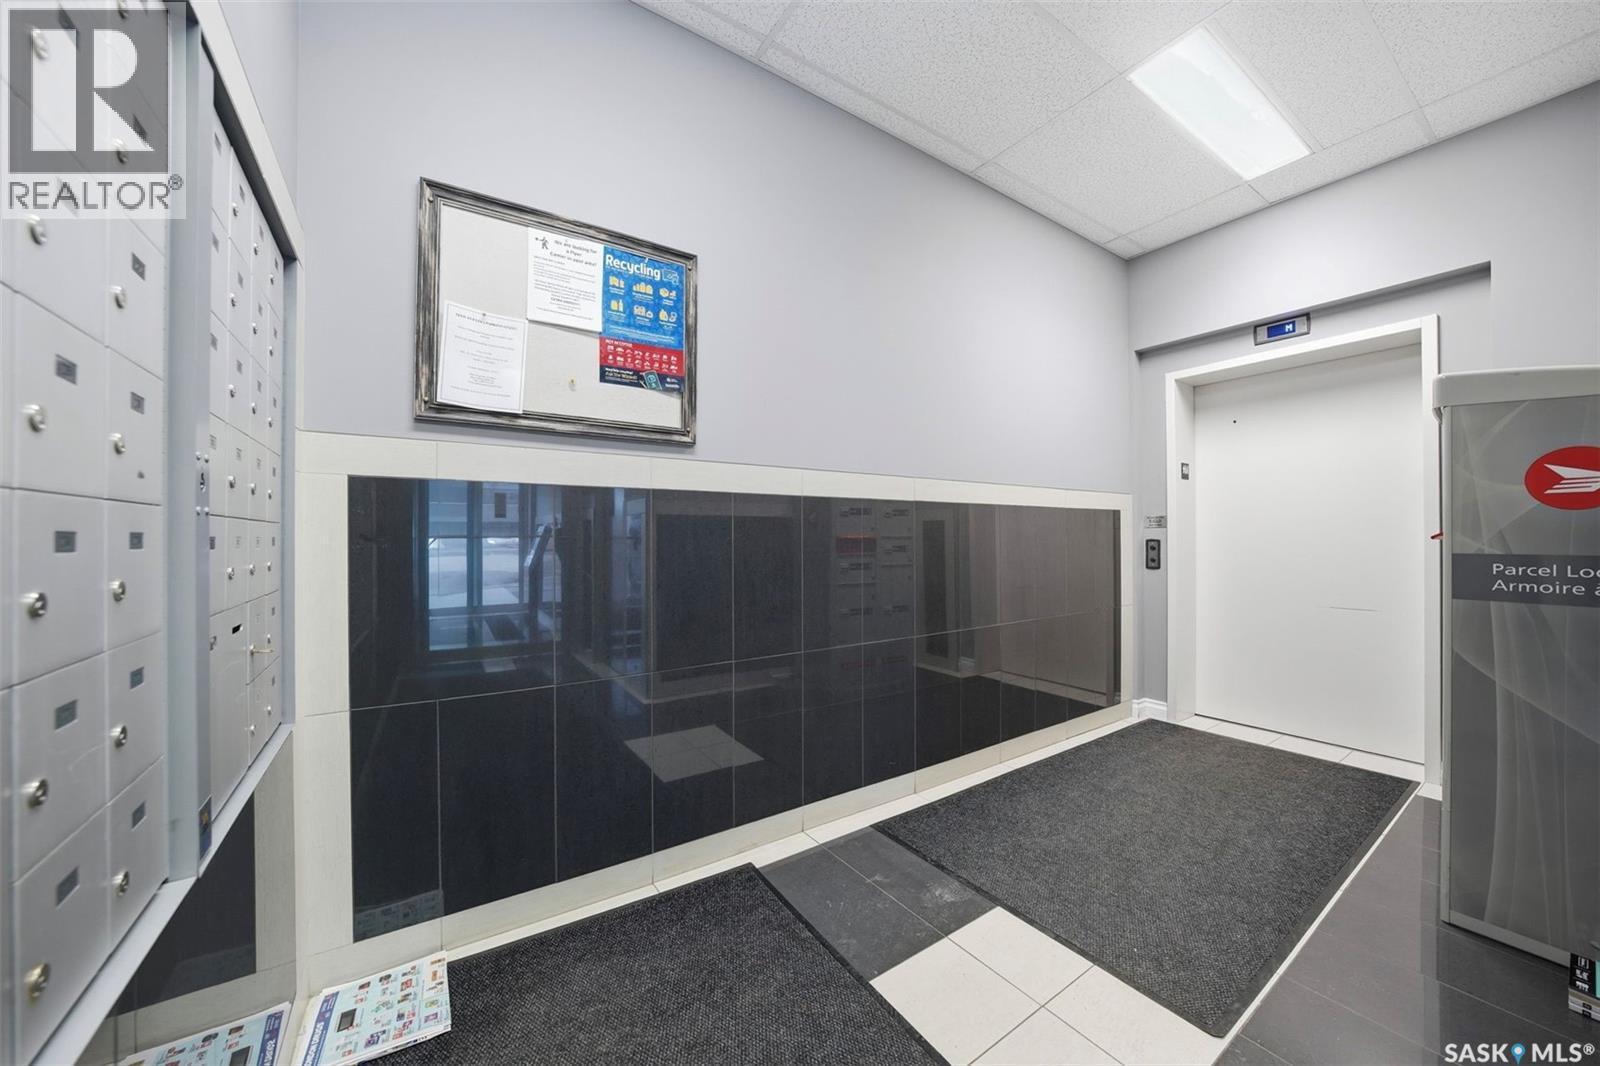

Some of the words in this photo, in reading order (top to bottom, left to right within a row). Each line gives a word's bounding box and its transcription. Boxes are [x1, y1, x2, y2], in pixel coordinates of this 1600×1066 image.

[605, 254, 661, 281] Recycling
[1285, 323, 1293, 333] M
[1492, 562, 1557, 578] Parcel
[1491, 579, 1586, 596] Armoire
